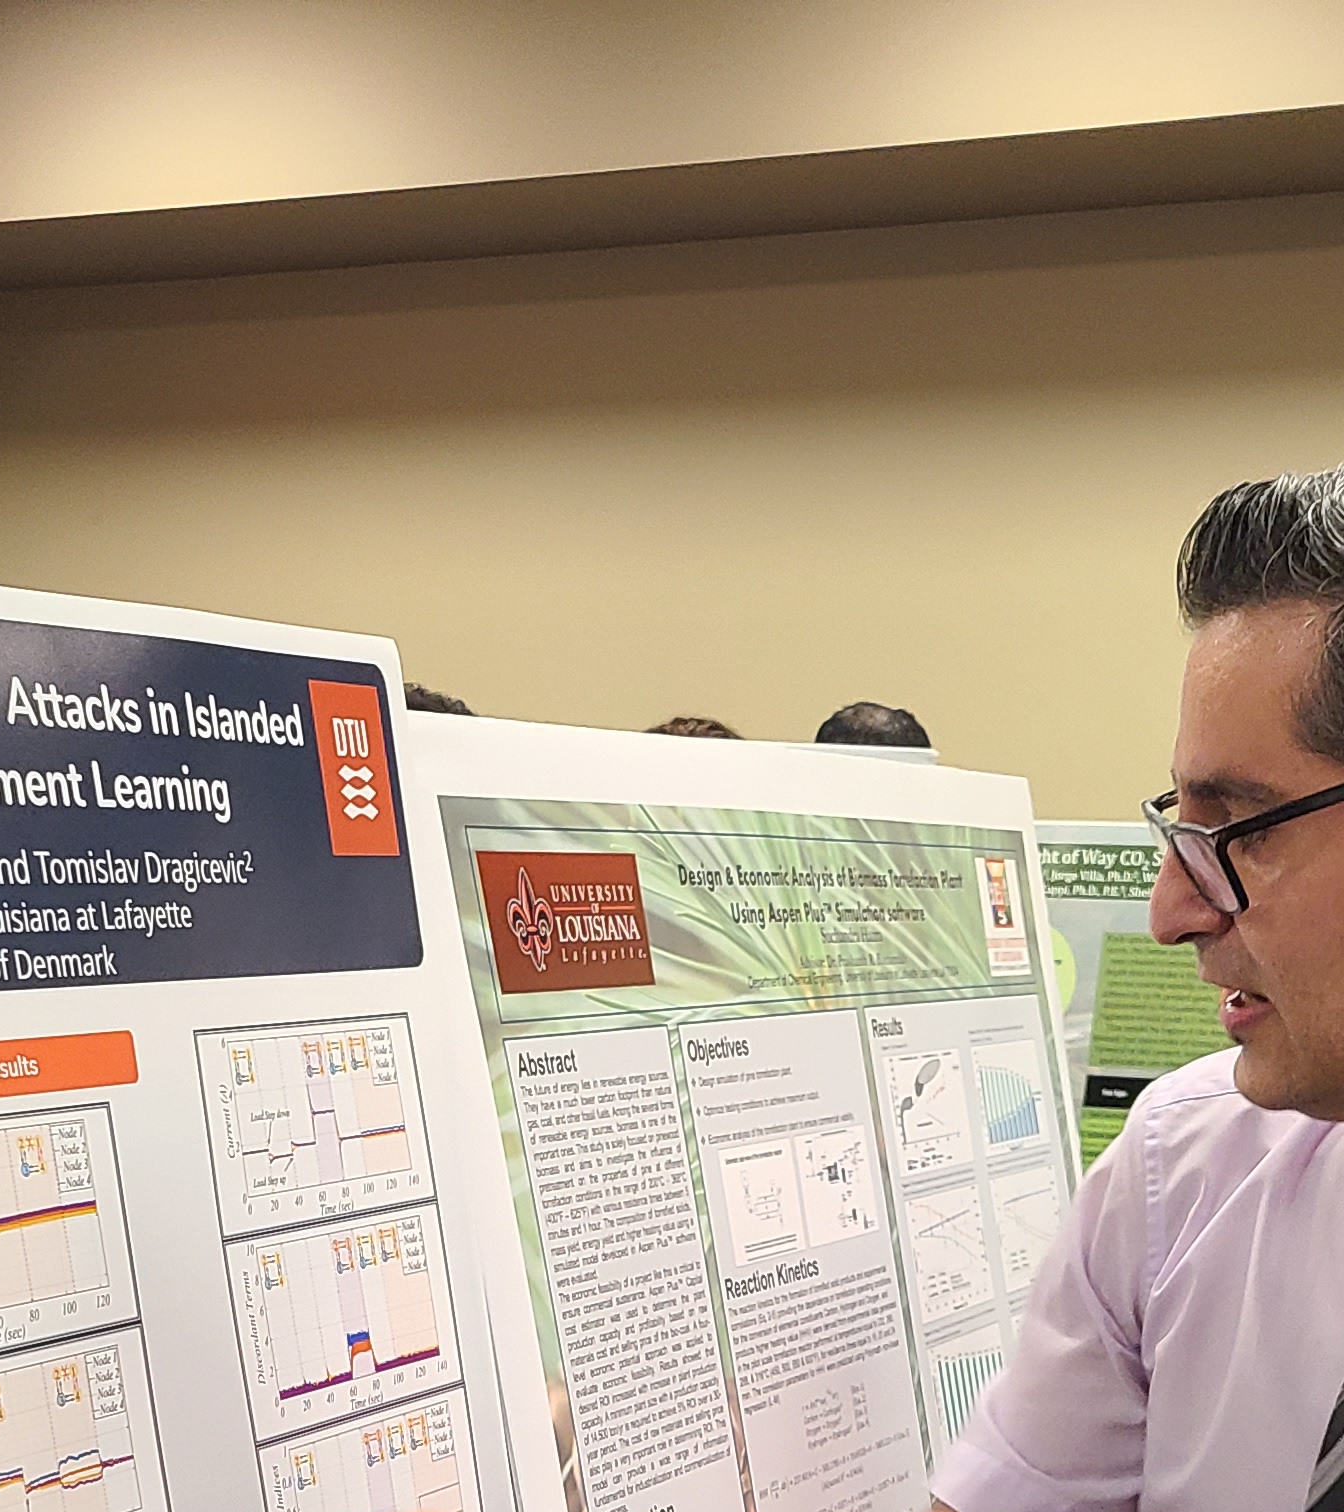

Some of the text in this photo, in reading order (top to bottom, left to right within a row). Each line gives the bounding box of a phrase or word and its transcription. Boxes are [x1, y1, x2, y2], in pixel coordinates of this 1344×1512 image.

[8, 683, 143, 735] Attacks
[149, 689, 178, 737] in
[187, 691, 305, 748] Islanded
[332, 717, 370, 758] DTU
[91, 760, 230, 823] Learning
[33, 849, 140, 886] Tomislav
[1062, 849, 1081, 864] of
[1082, 849, 1118, 869] Way
[678, 864, 722, 892] Design
[726, 867, 734, 886] &
[737, 866, 788, 888] Economic
[792, 867, 834, 892] Analysis
[837, 868, 846, 887] of
[848, 868, 888, 888] Biomass
[549, 885, 634, 902] UNIVERSITY
[76, 903, 98, 933] at
[103, 901, 193, 938] Lafayette
[555, 915, 641, 942] LOUISIANA
[731, 902, 766, 929] Using
[769, 902, 802, 928] Aspen
[835, 902, 885, 922] Simulation
[888, 902, 925, 922] software
[14, 947, 118, 982] Denmark
[871, 1015, 903, 1040] Results
[518, 1049, 577, 1078] Abstract
[687, 1037, 750, 1066] Objectives
[724, 1257, 819, 1302] Reaction Kinetics
